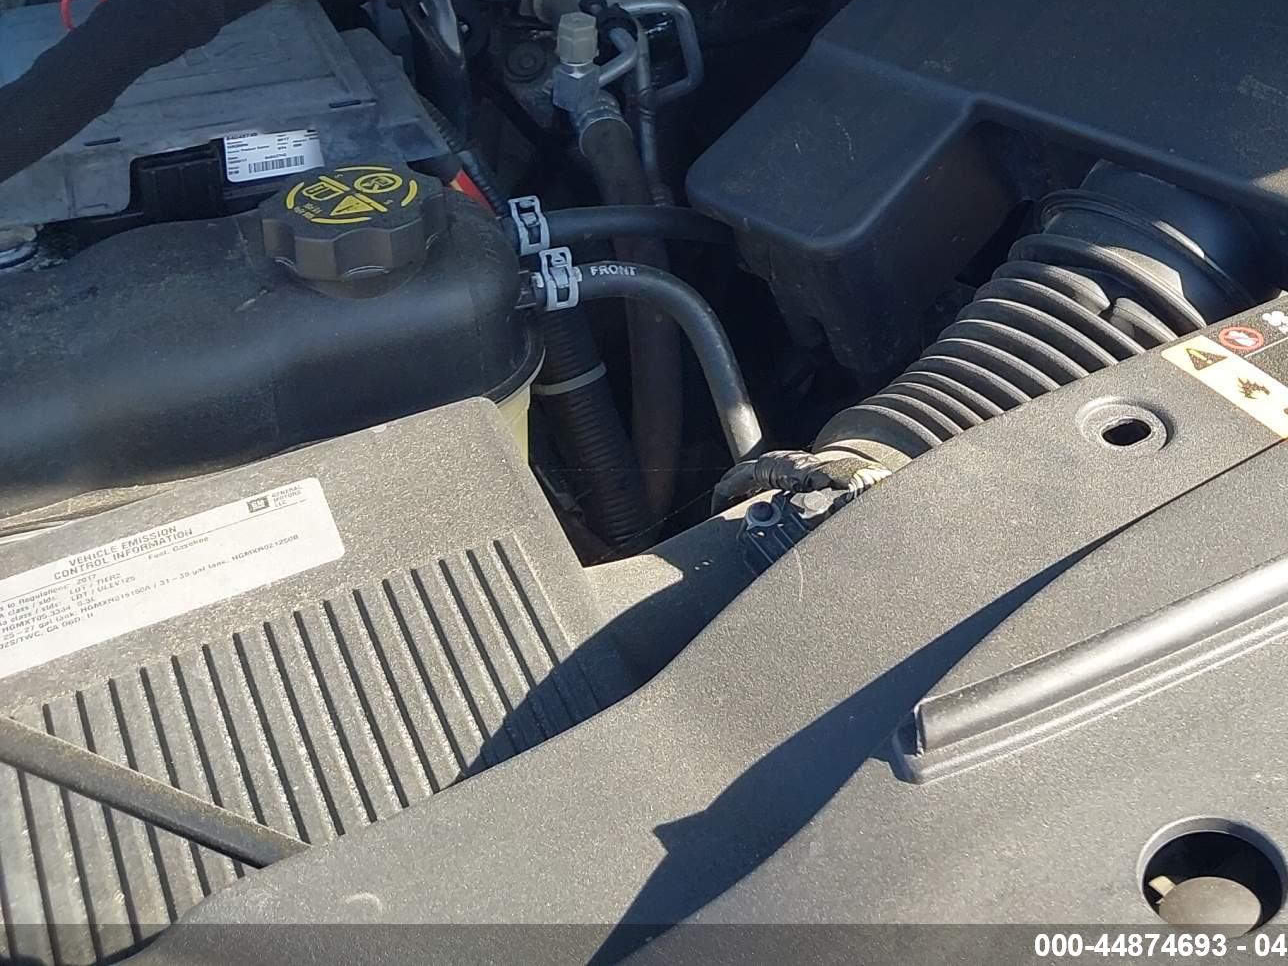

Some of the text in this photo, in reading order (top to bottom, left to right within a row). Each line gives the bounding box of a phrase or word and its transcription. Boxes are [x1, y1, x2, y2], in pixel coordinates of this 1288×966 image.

[590, 264, 637, 276] FRONT
[54, 528, 193, 580] CONTROL INFORMATION
[69, 526, 177, 566] VEHICLE EMISSION
[77, 574, 97, 585] 2017
